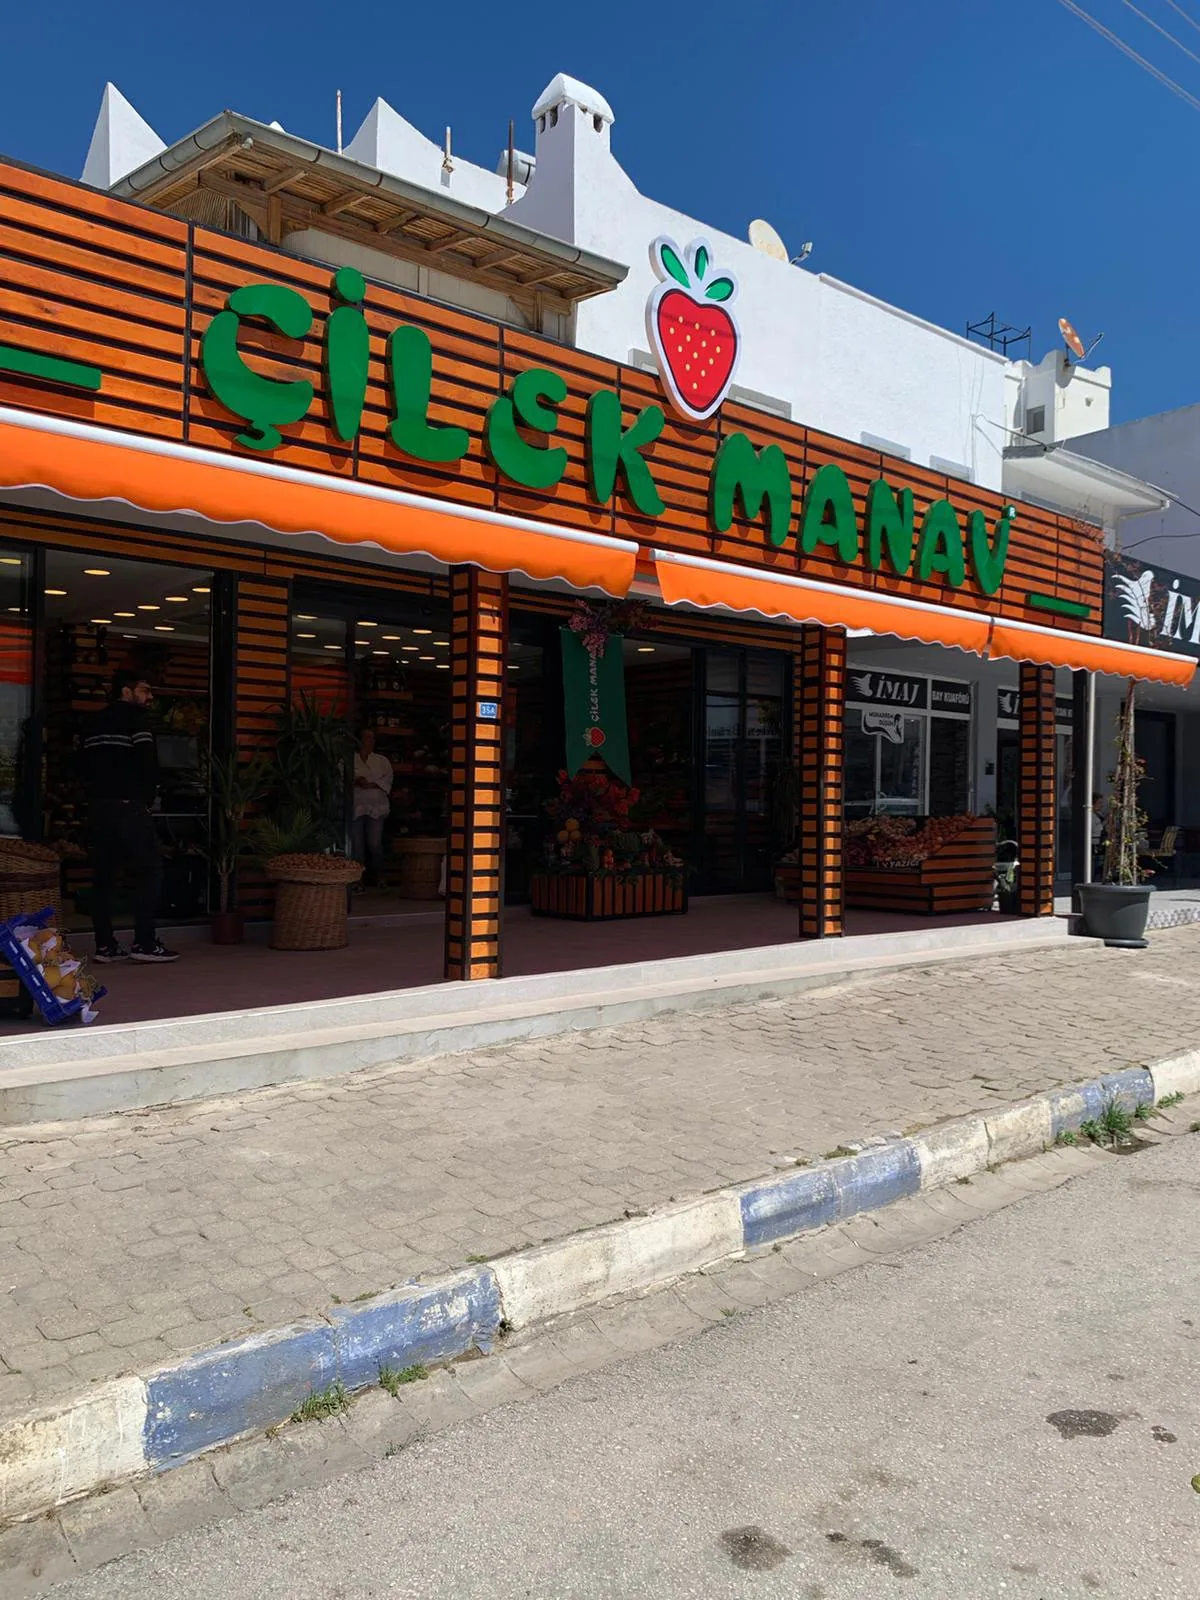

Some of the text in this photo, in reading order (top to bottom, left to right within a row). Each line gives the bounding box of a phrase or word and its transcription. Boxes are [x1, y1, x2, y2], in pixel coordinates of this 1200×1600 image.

[202, 267, 1013, 597] ÇİLEK MANAV
[875, 674, 920, 704] İMAJ
